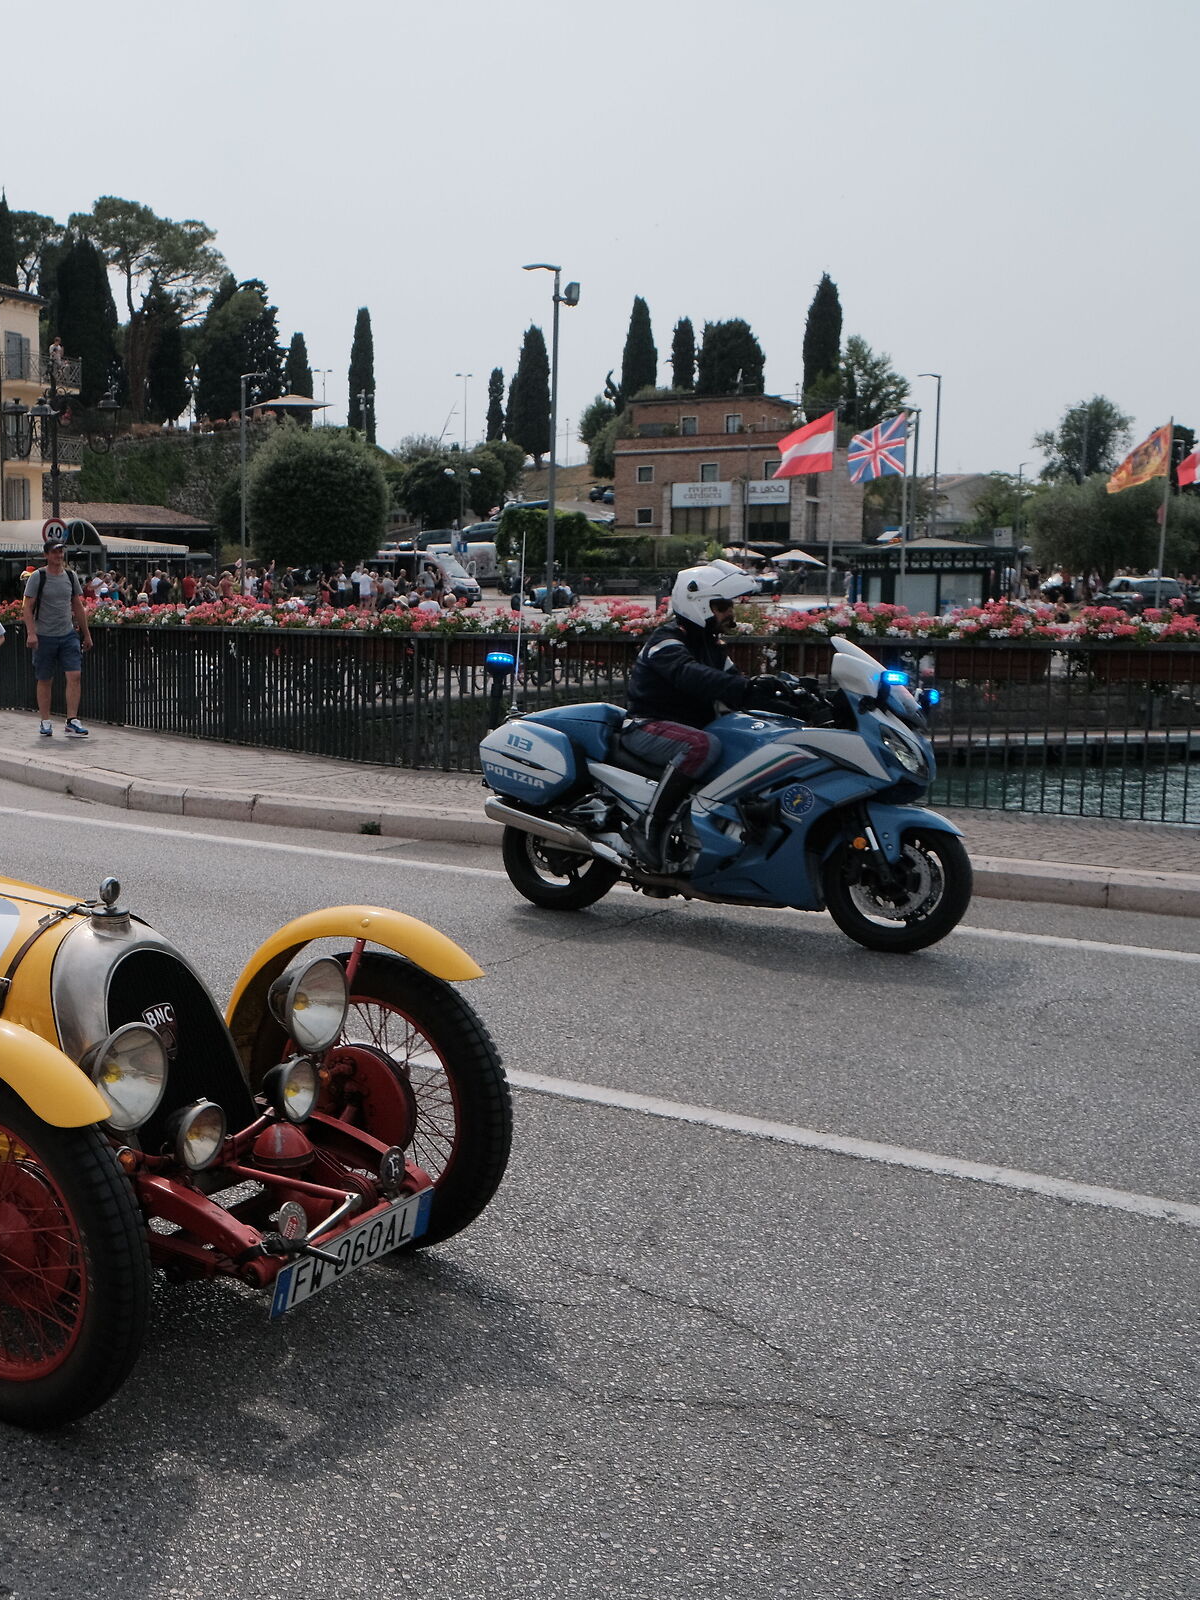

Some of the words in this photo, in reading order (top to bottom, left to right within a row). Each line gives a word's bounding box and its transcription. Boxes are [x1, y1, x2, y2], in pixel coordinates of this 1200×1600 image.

[47, 526, 63, 539] 40
[507, 733, 533, 752] 113
[486, 763, 545, 789] POLIZIA
[145, 1005, 174, 1028] BNC
[291, 1256, 325, 1303] FW
